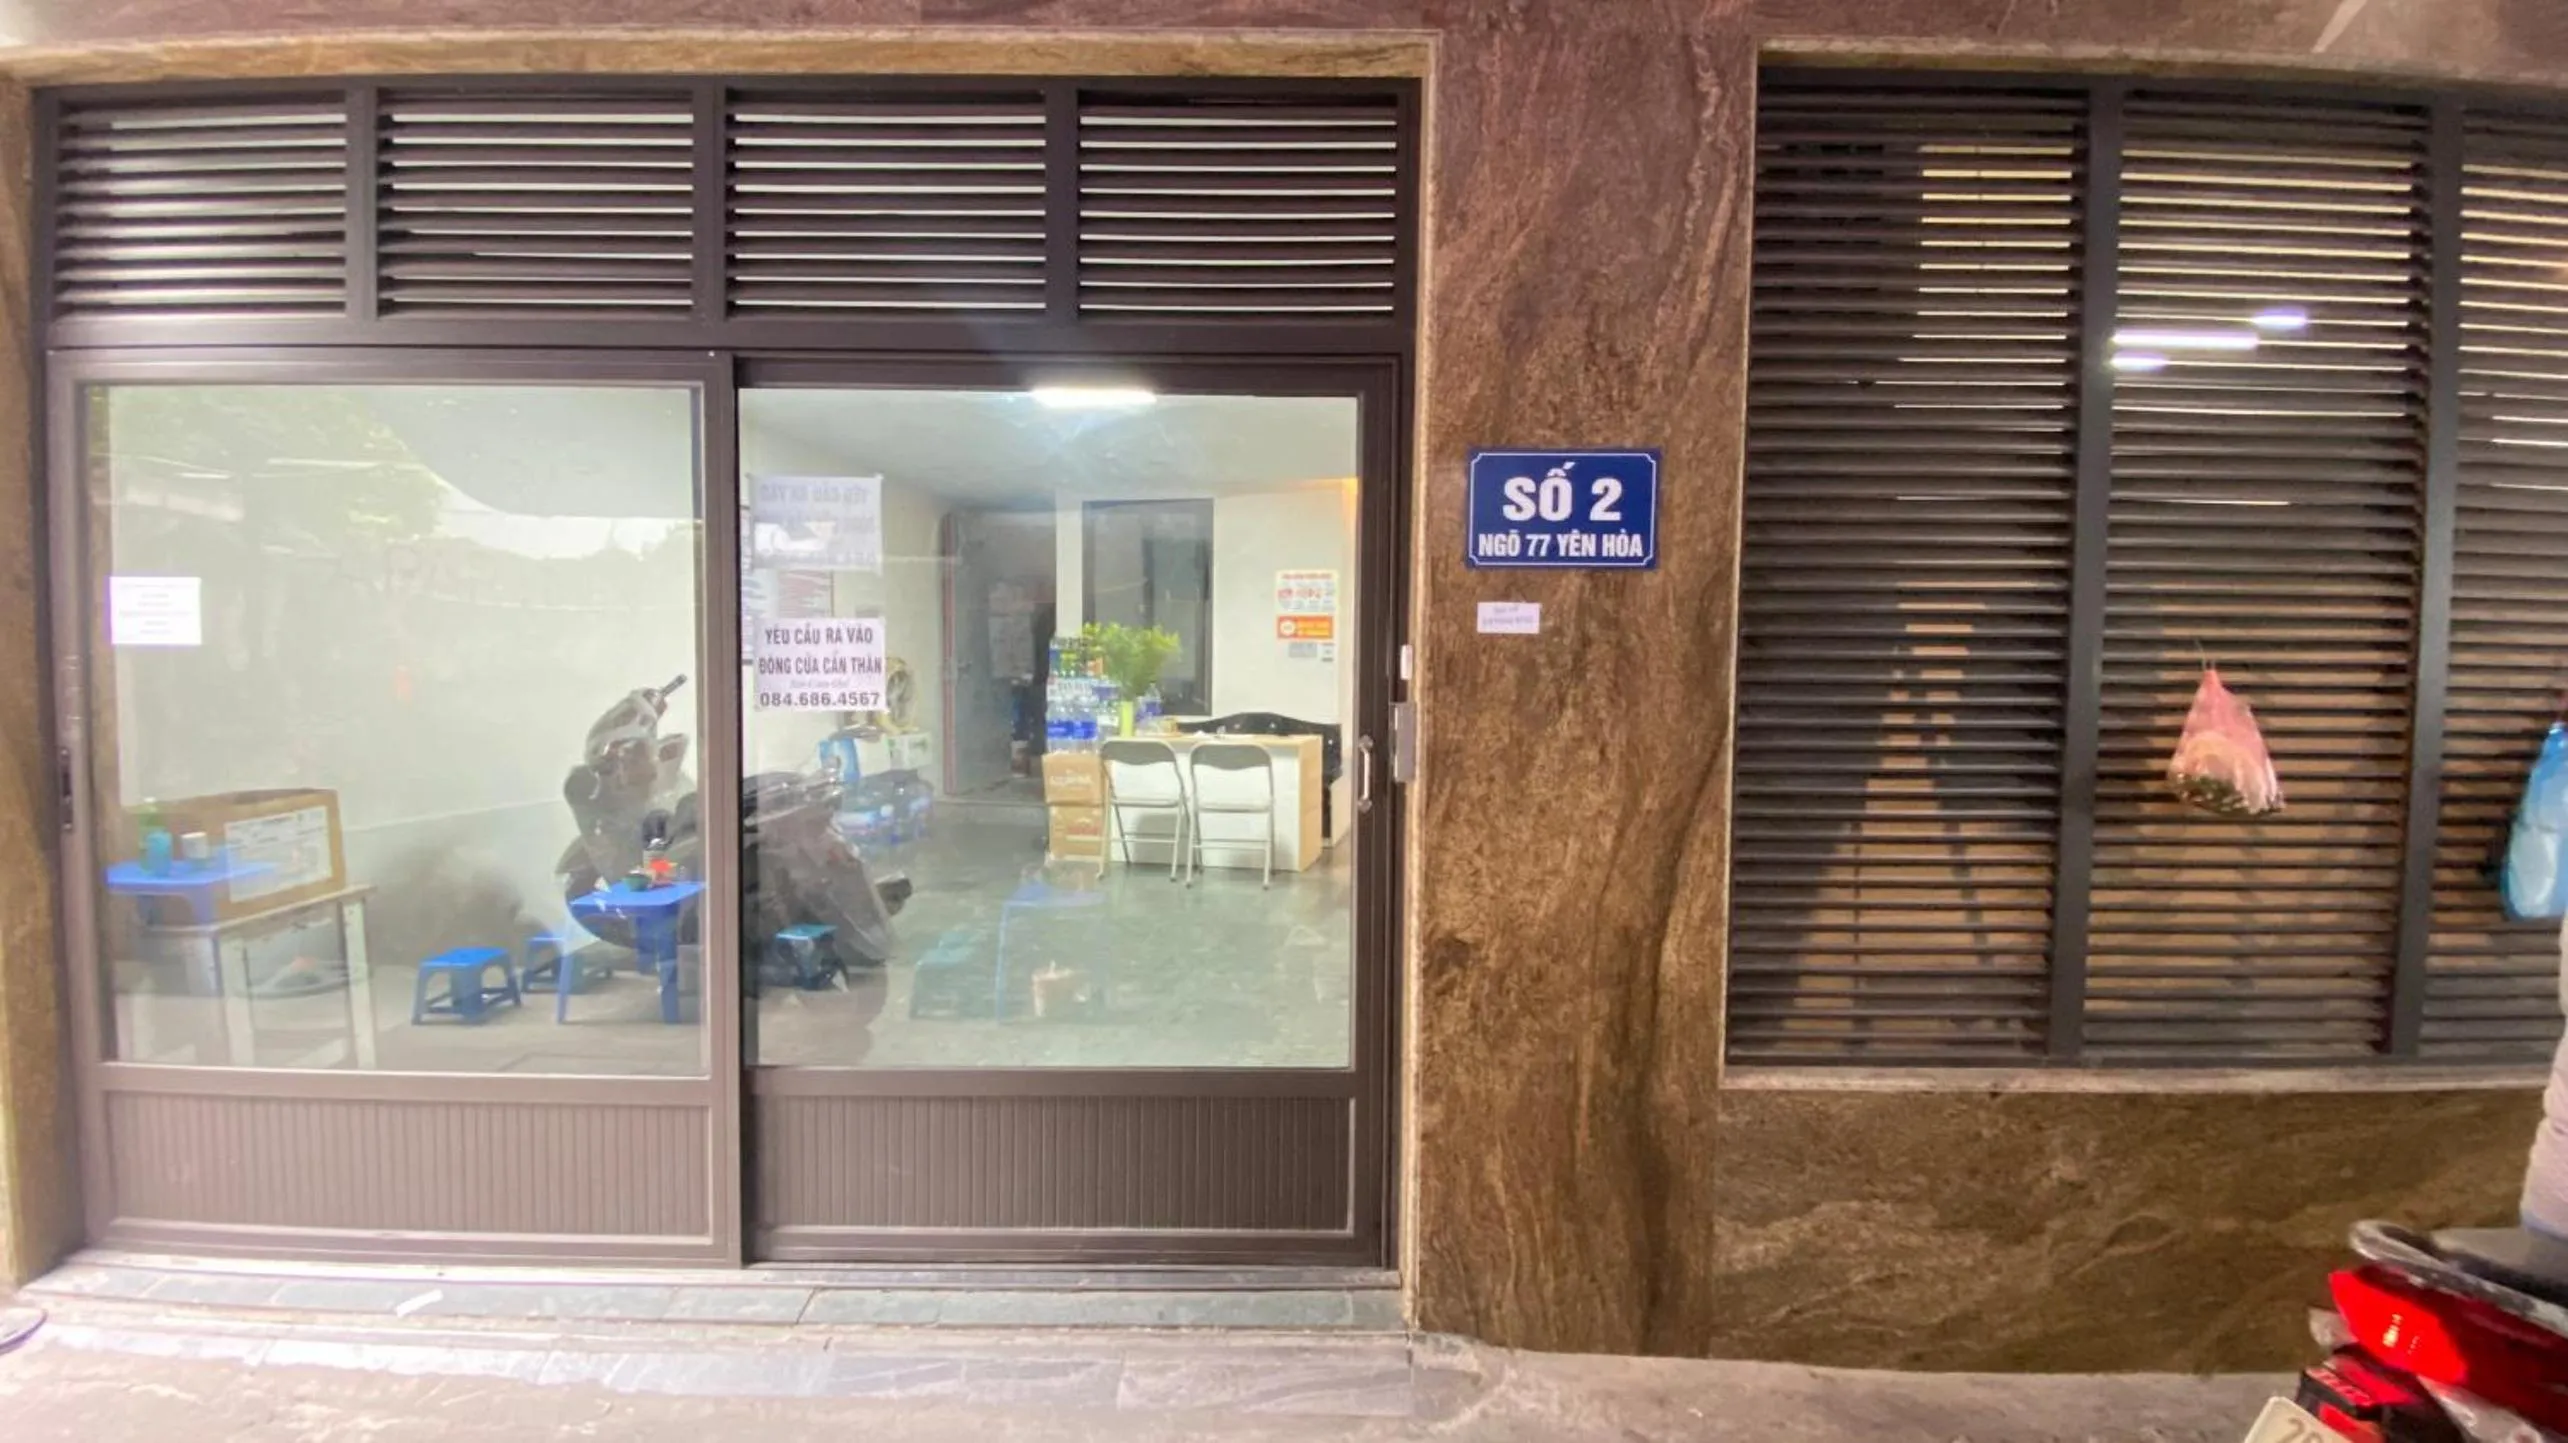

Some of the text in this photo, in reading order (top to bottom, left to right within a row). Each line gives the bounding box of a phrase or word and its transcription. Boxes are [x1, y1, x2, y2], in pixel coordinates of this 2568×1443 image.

[1502, 461, 1622, 522] SỐ 2
[1478, 527, 1643, 557] NGÕ 77 YÊN HÒA
[825, 627, 843, 644] RA
[760, 692, 880, 706] 084.686.4567
